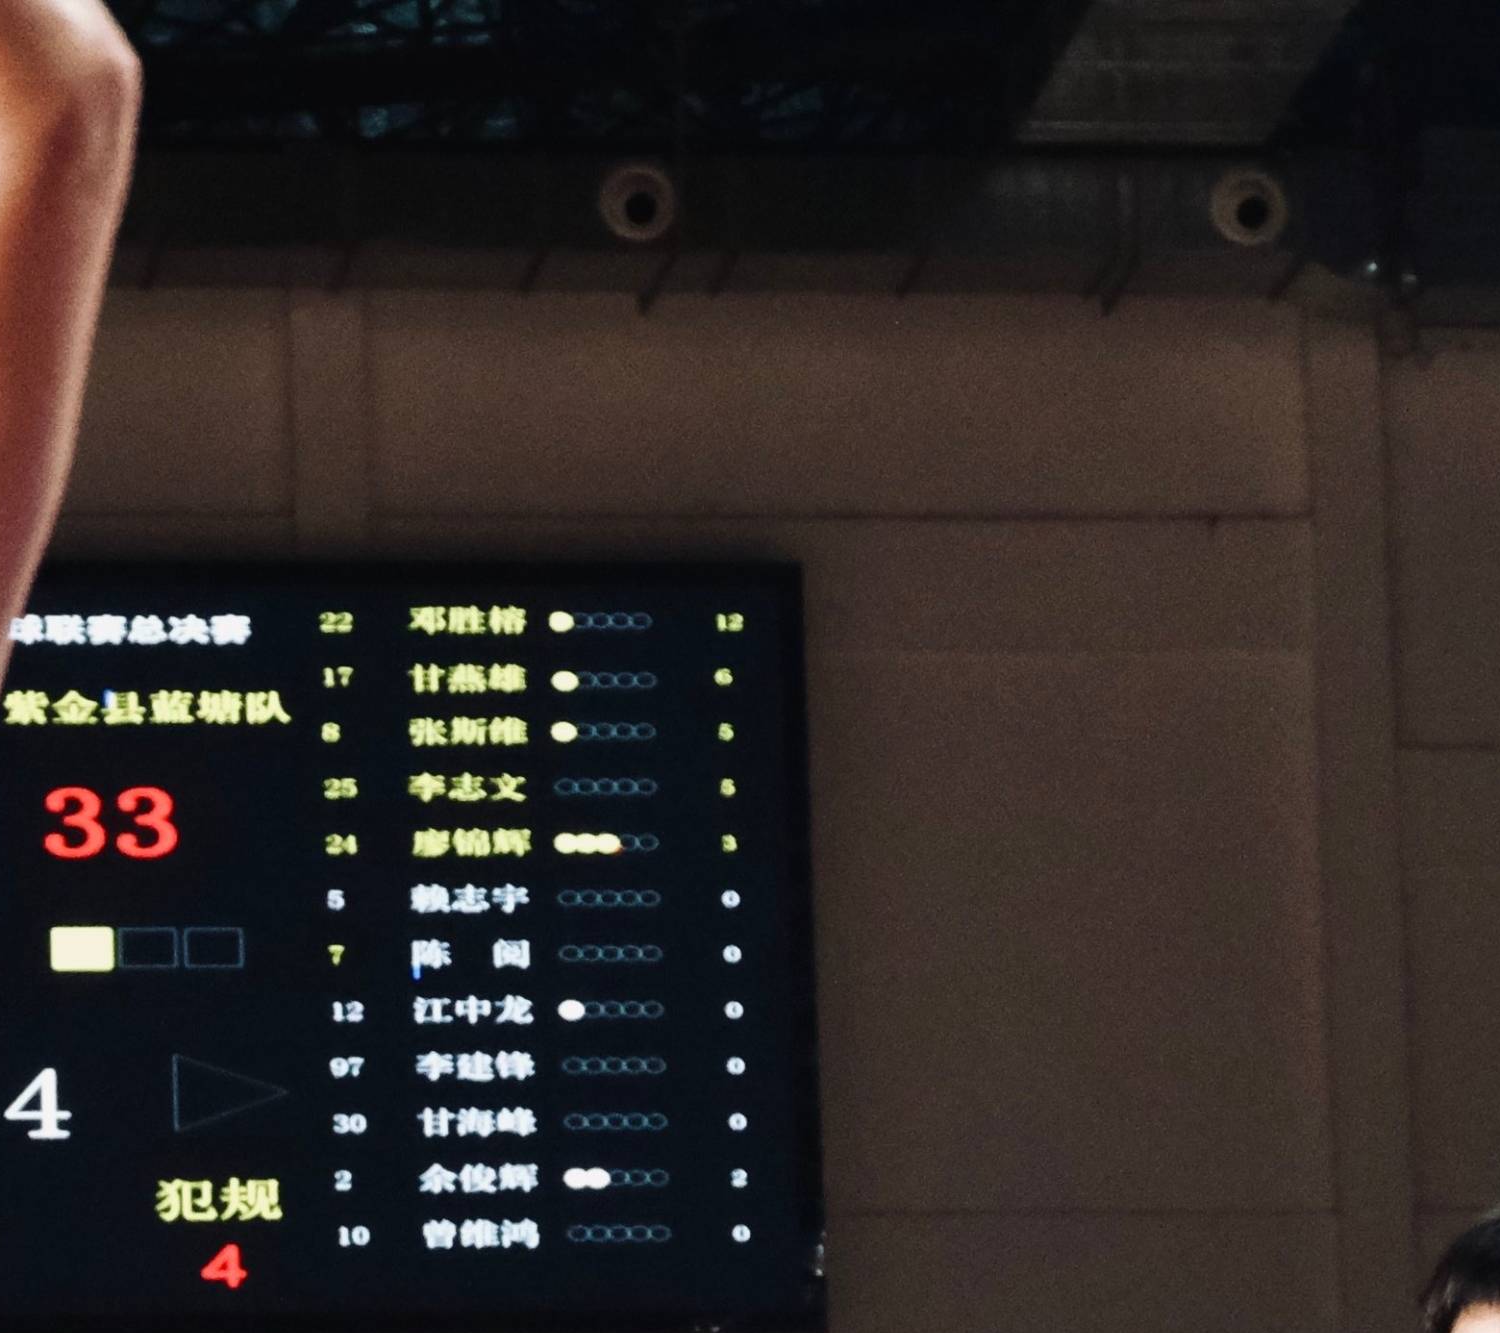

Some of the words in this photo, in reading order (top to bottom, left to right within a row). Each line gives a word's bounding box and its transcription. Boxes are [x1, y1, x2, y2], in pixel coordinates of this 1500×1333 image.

[10, 613, 252, 645] 球联赛总决赛
[319, 611, 354, 634] 22
[716, 612, 744, 632] 12
[323, 666, 354, 688] 17
[714, 667, 734, 686] 6
[3, 689, 291, 726] 紫金县蓝塘队
[321, 722, 341, 743] 8
[323, 777, 358, 800] 25
[409, 772, 526, 802] 李志文
[43, 786, 179, 859] 33
[325, 833, 358, 855] 24
[326, 889, 346, 911] 5
[720, 889, 741, 909] 0
[327, 944, 345, 965] 7
[722, 944, 742, 964] 0
[332, 1000, 365, 1023] 12
[413, 994, 534, 1024] 江中龙
[724, 1000, 744, 1020] 0
[329, 1056, 365, 1079] 97
[726, 1056, 746, 1075] 0
[332, 1113, 368, 1135] 30
[728, 1112, 748, 1131] 0
[334, 1169, 353, 1192] 2
[731, 1168, 748, 1188] 2
[155, 1176, 283, 1223] 犯规
[338, 1225, 371, 1248] 10
[731, 1224, 751, 1243] 0
[200, 1243, 248, 1289] 4
